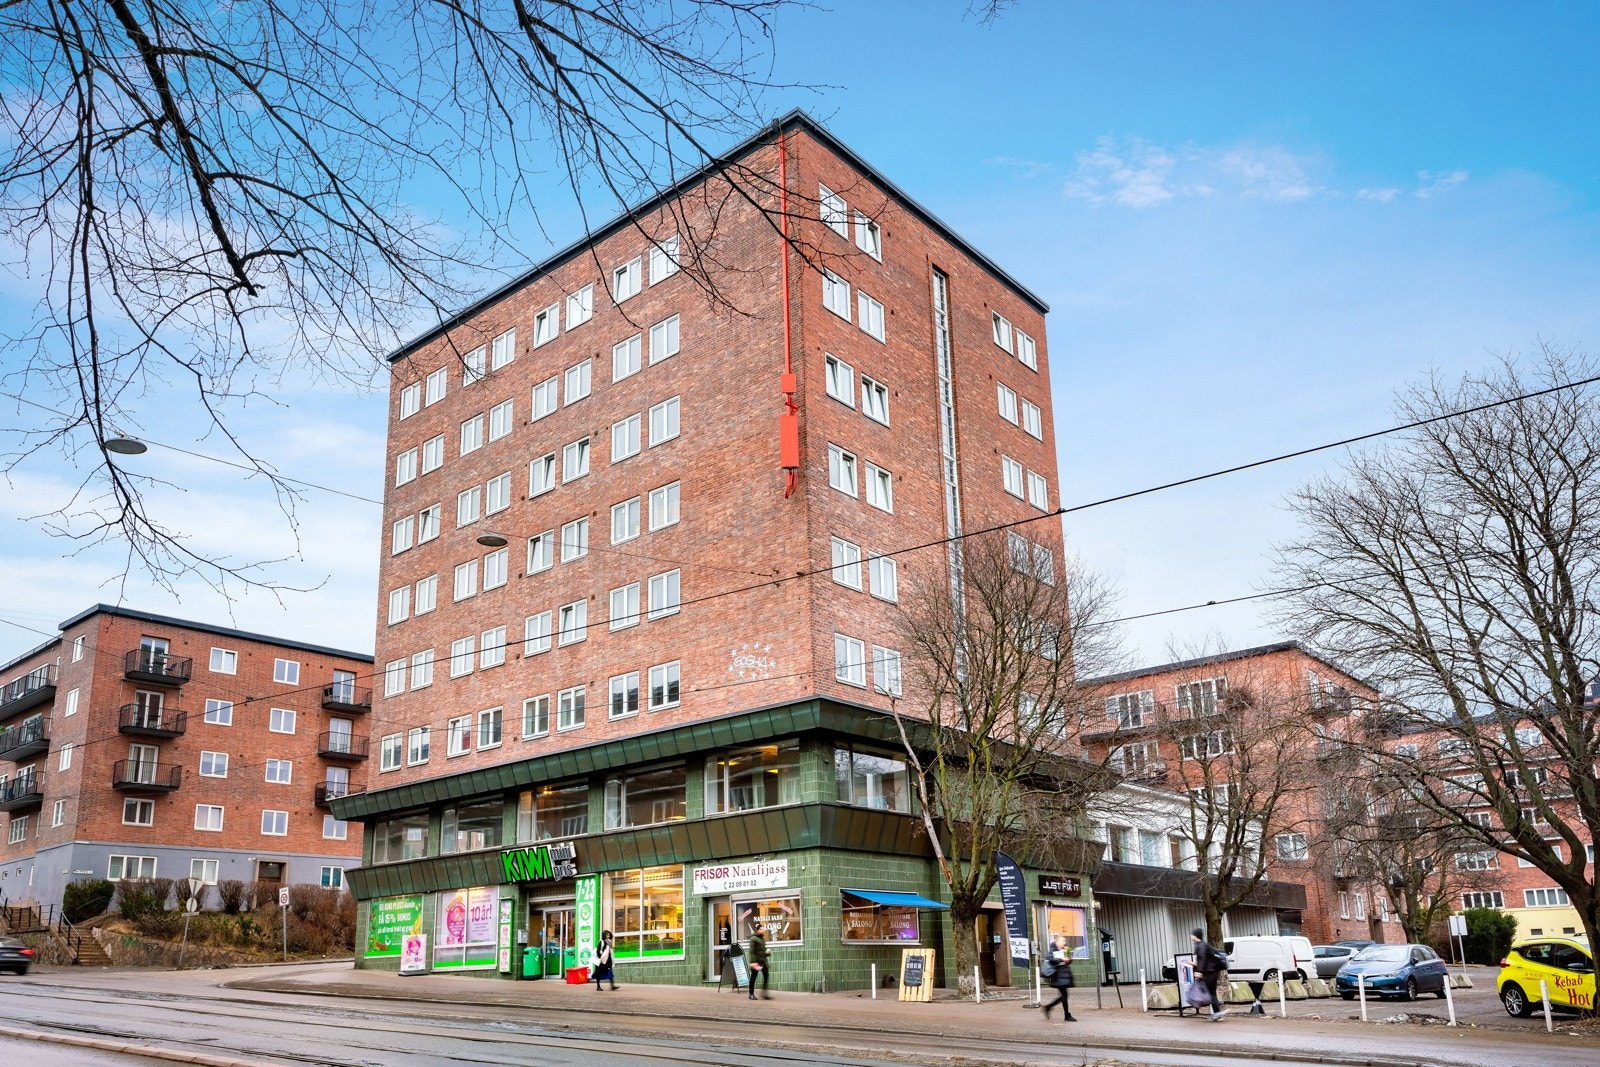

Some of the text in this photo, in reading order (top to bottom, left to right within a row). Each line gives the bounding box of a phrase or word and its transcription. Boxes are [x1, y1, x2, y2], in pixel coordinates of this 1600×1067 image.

[550, 843, 575, 861] mini
[501, 846, 553, 883] KIWI
[553, 861, 577, 881] pris
[694, 864, 786, 881] FRISØR Natalijass
[576, 879, 596, 901] 7-23
[750, 879, 757, 887] 02
[1042, 881, 1061, 889] JUST
[1062, 882, 1072, 891] FIX
[378, 912, 385, 924] FÅ
[470, 906, 481, 922] 10
[481, 904, 493, 920] år!
[755, 922, 782, 931] SLONG
[851, 920, 873, 928] SALONG
[890, 921, 910, 929] SALONG
[1567, 988, 1591, 1006] Hot
